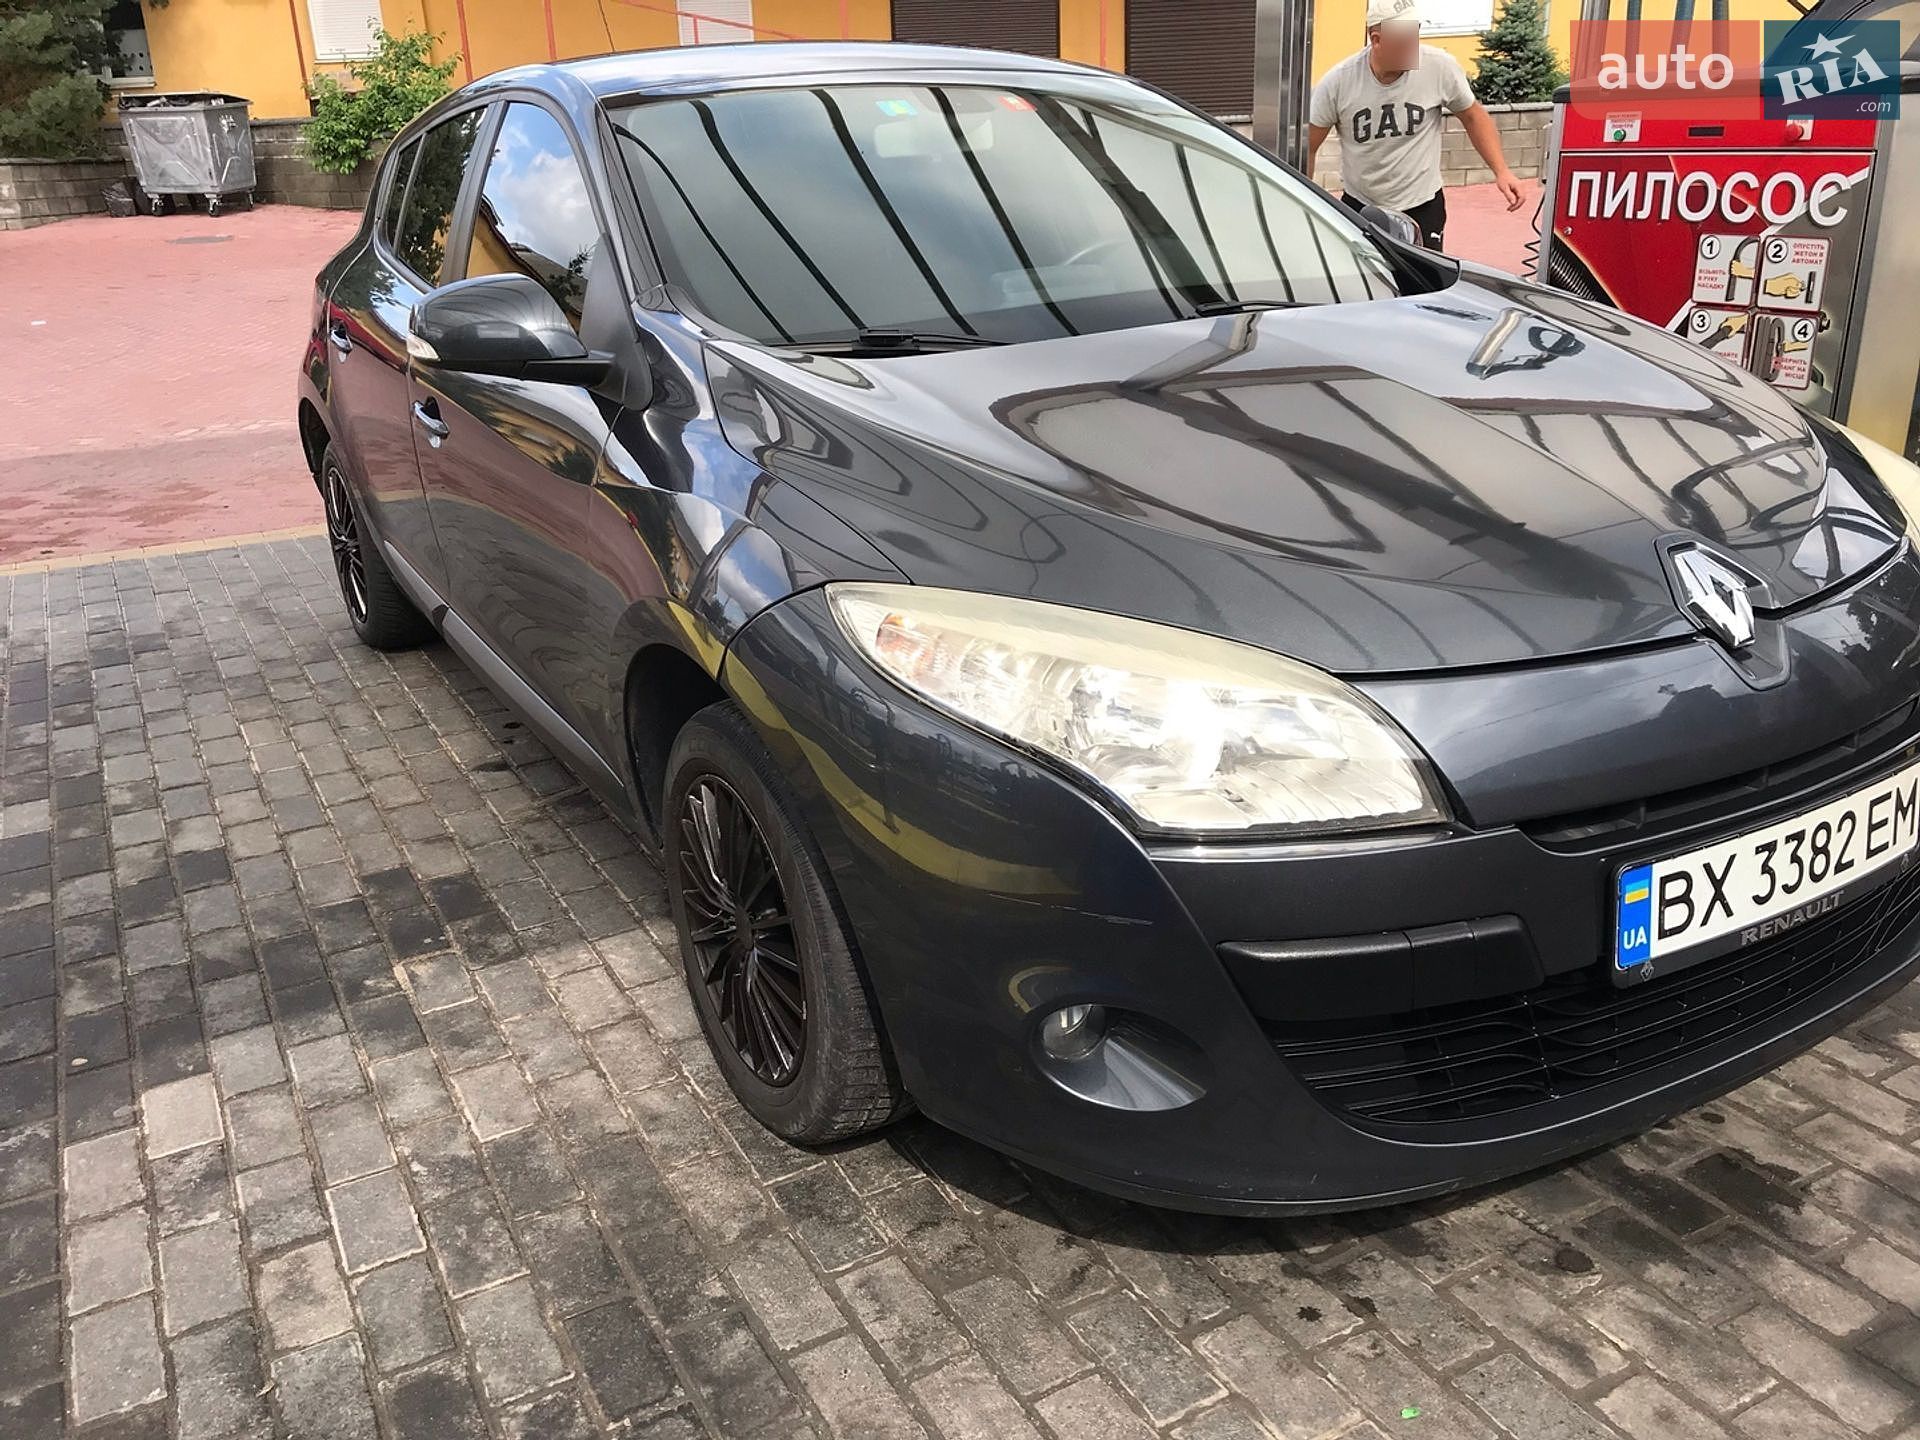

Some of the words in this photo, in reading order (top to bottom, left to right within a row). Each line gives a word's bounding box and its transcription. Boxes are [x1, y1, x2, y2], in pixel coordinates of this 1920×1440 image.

[1353, 102, 1426, 144] GAP
[1568, 171, 1851, 227] ПИЛОСОС
[1706, 240, 1714, 255] 1
[1771, 243, 1784, 259] 2
[1697, 315, 1706, 329] 3
[1798, 324, 1809, 338] 4
[1658, 853, 1738, 940] BX
[1752, 811, 1856, 906] 3382
[1866, 777, 1918, 860] EM
[1741, 890, 1844, 946] RENAULT
[1623, 926, 1648, 950] UA
